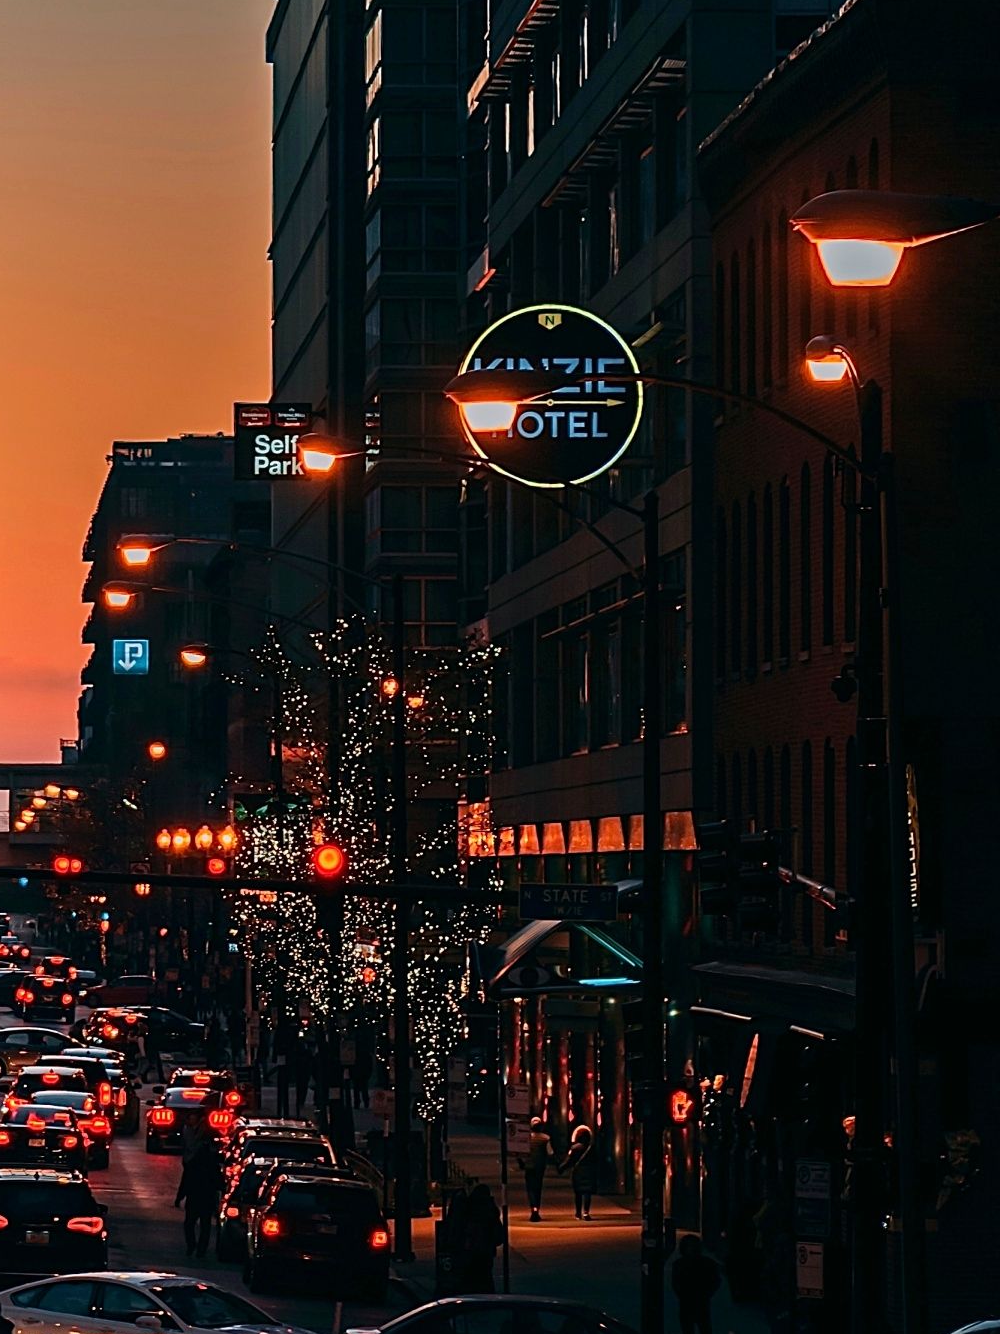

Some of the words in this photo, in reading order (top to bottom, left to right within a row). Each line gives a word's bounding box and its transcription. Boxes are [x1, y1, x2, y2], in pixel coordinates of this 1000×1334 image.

[491, 410, 609, 439] OTEL
[254, 434, 300, 455] Self
[253, 455, 305, 476] Park
[543, 889, 589, 904] STATE
[600, 892, 613, 902] ST
